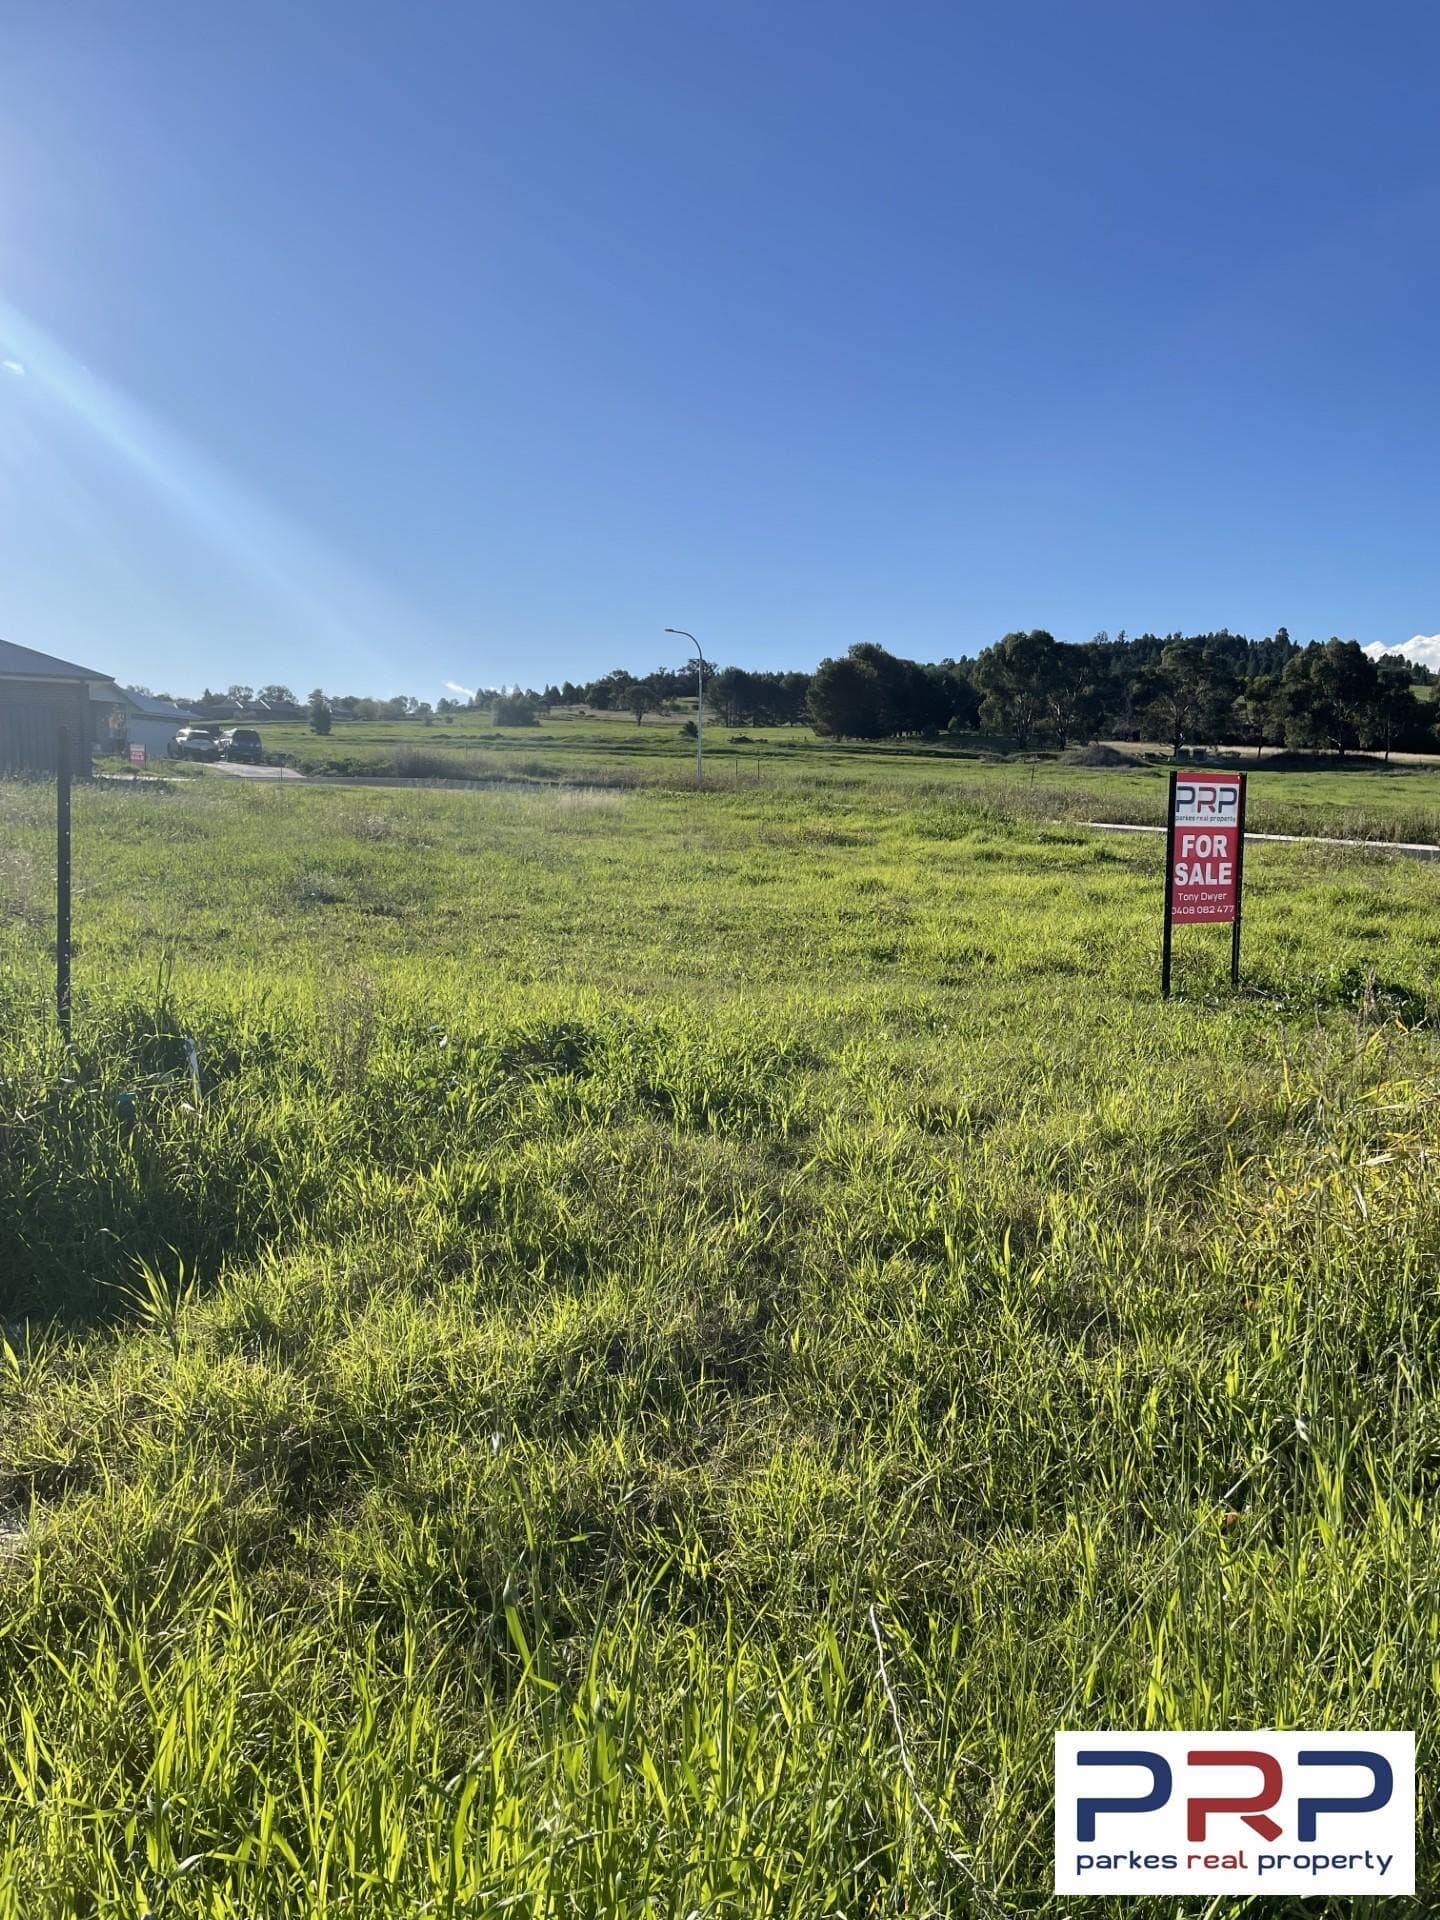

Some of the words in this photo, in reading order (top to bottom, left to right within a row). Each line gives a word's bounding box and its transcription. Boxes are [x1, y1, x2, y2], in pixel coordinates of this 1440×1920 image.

[1175, 785, 1238, 814] PRP
[1181, 834, 1228, 858] FOR
[1174, 862, 1233, 886] SALE
[1178, 892, 1199, 903] Tony
[1200, 892, 1228, 903] Dwyer
[1196, 905, 1216, 914] 082
[1216, 904, 1235, 913] 477
